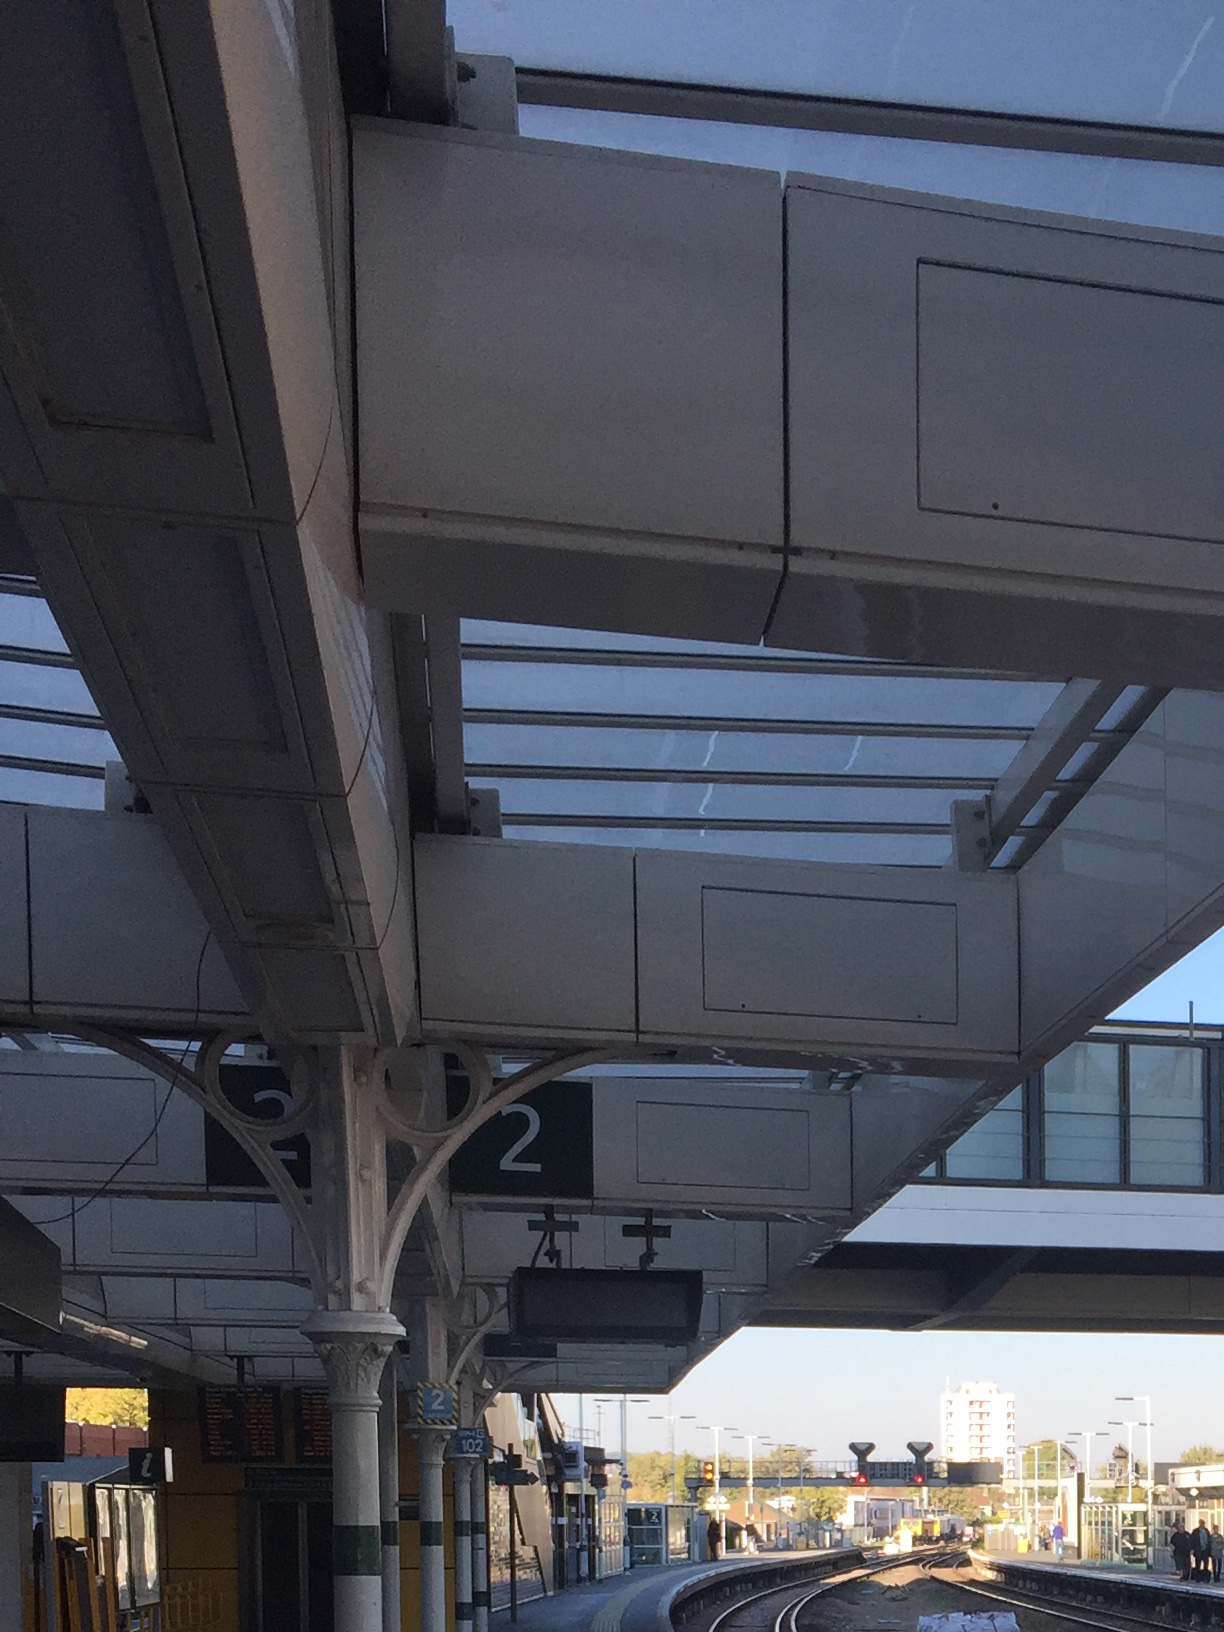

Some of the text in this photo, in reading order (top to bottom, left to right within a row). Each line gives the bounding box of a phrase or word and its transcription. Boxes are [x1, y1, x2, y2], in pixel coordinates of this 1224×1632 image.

[499, 1103, 542, 1173] 2
[430, 1389, 445, 1410] 2
[461, 1439, 483, 1452] 102
